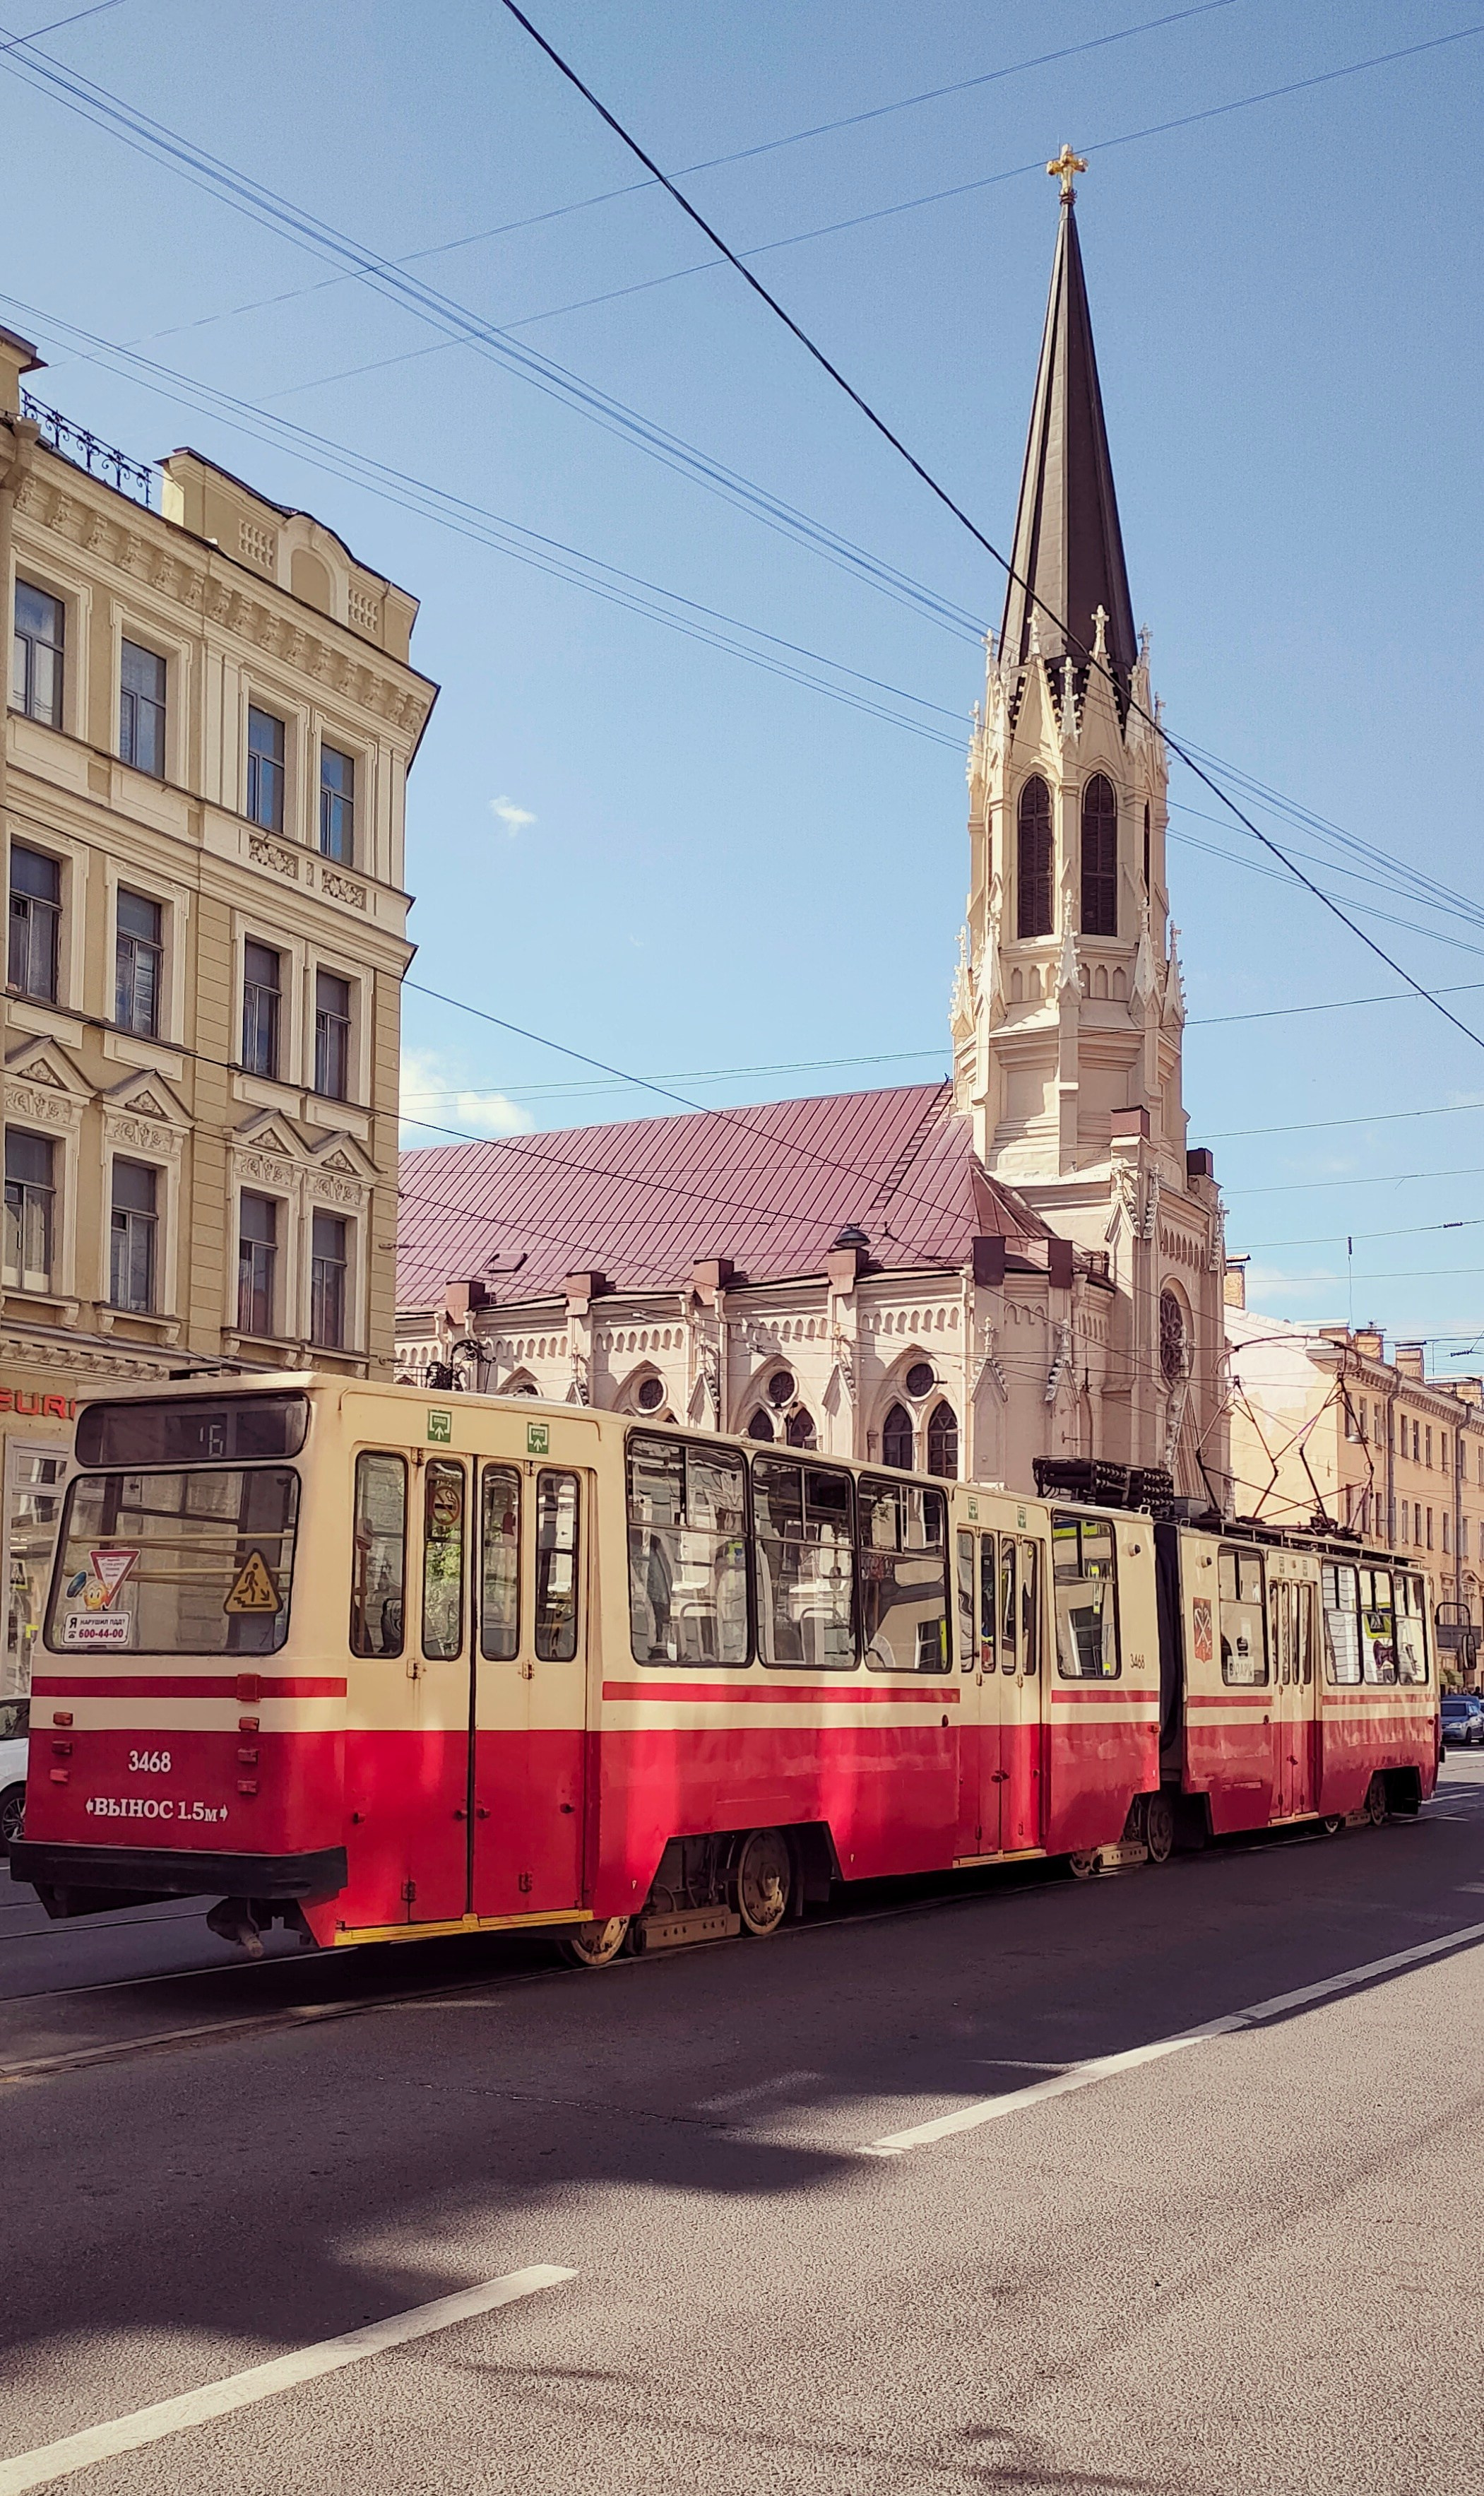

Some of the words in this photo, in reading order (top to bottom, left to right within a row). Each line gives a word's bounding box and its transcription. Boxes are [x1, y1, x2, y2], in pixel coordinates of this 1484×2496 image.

[69, 1617, 77, 1628] Я
[78, 1628, 124, 1638] 600-44-00
[1130, 1653, 1145, 1669] 3468
[128, 1750, 172, 1773] 3468
[93, 1797, 174, 1819] ВЫНОС
[177, 1801, 218, 1822] 1.5м
